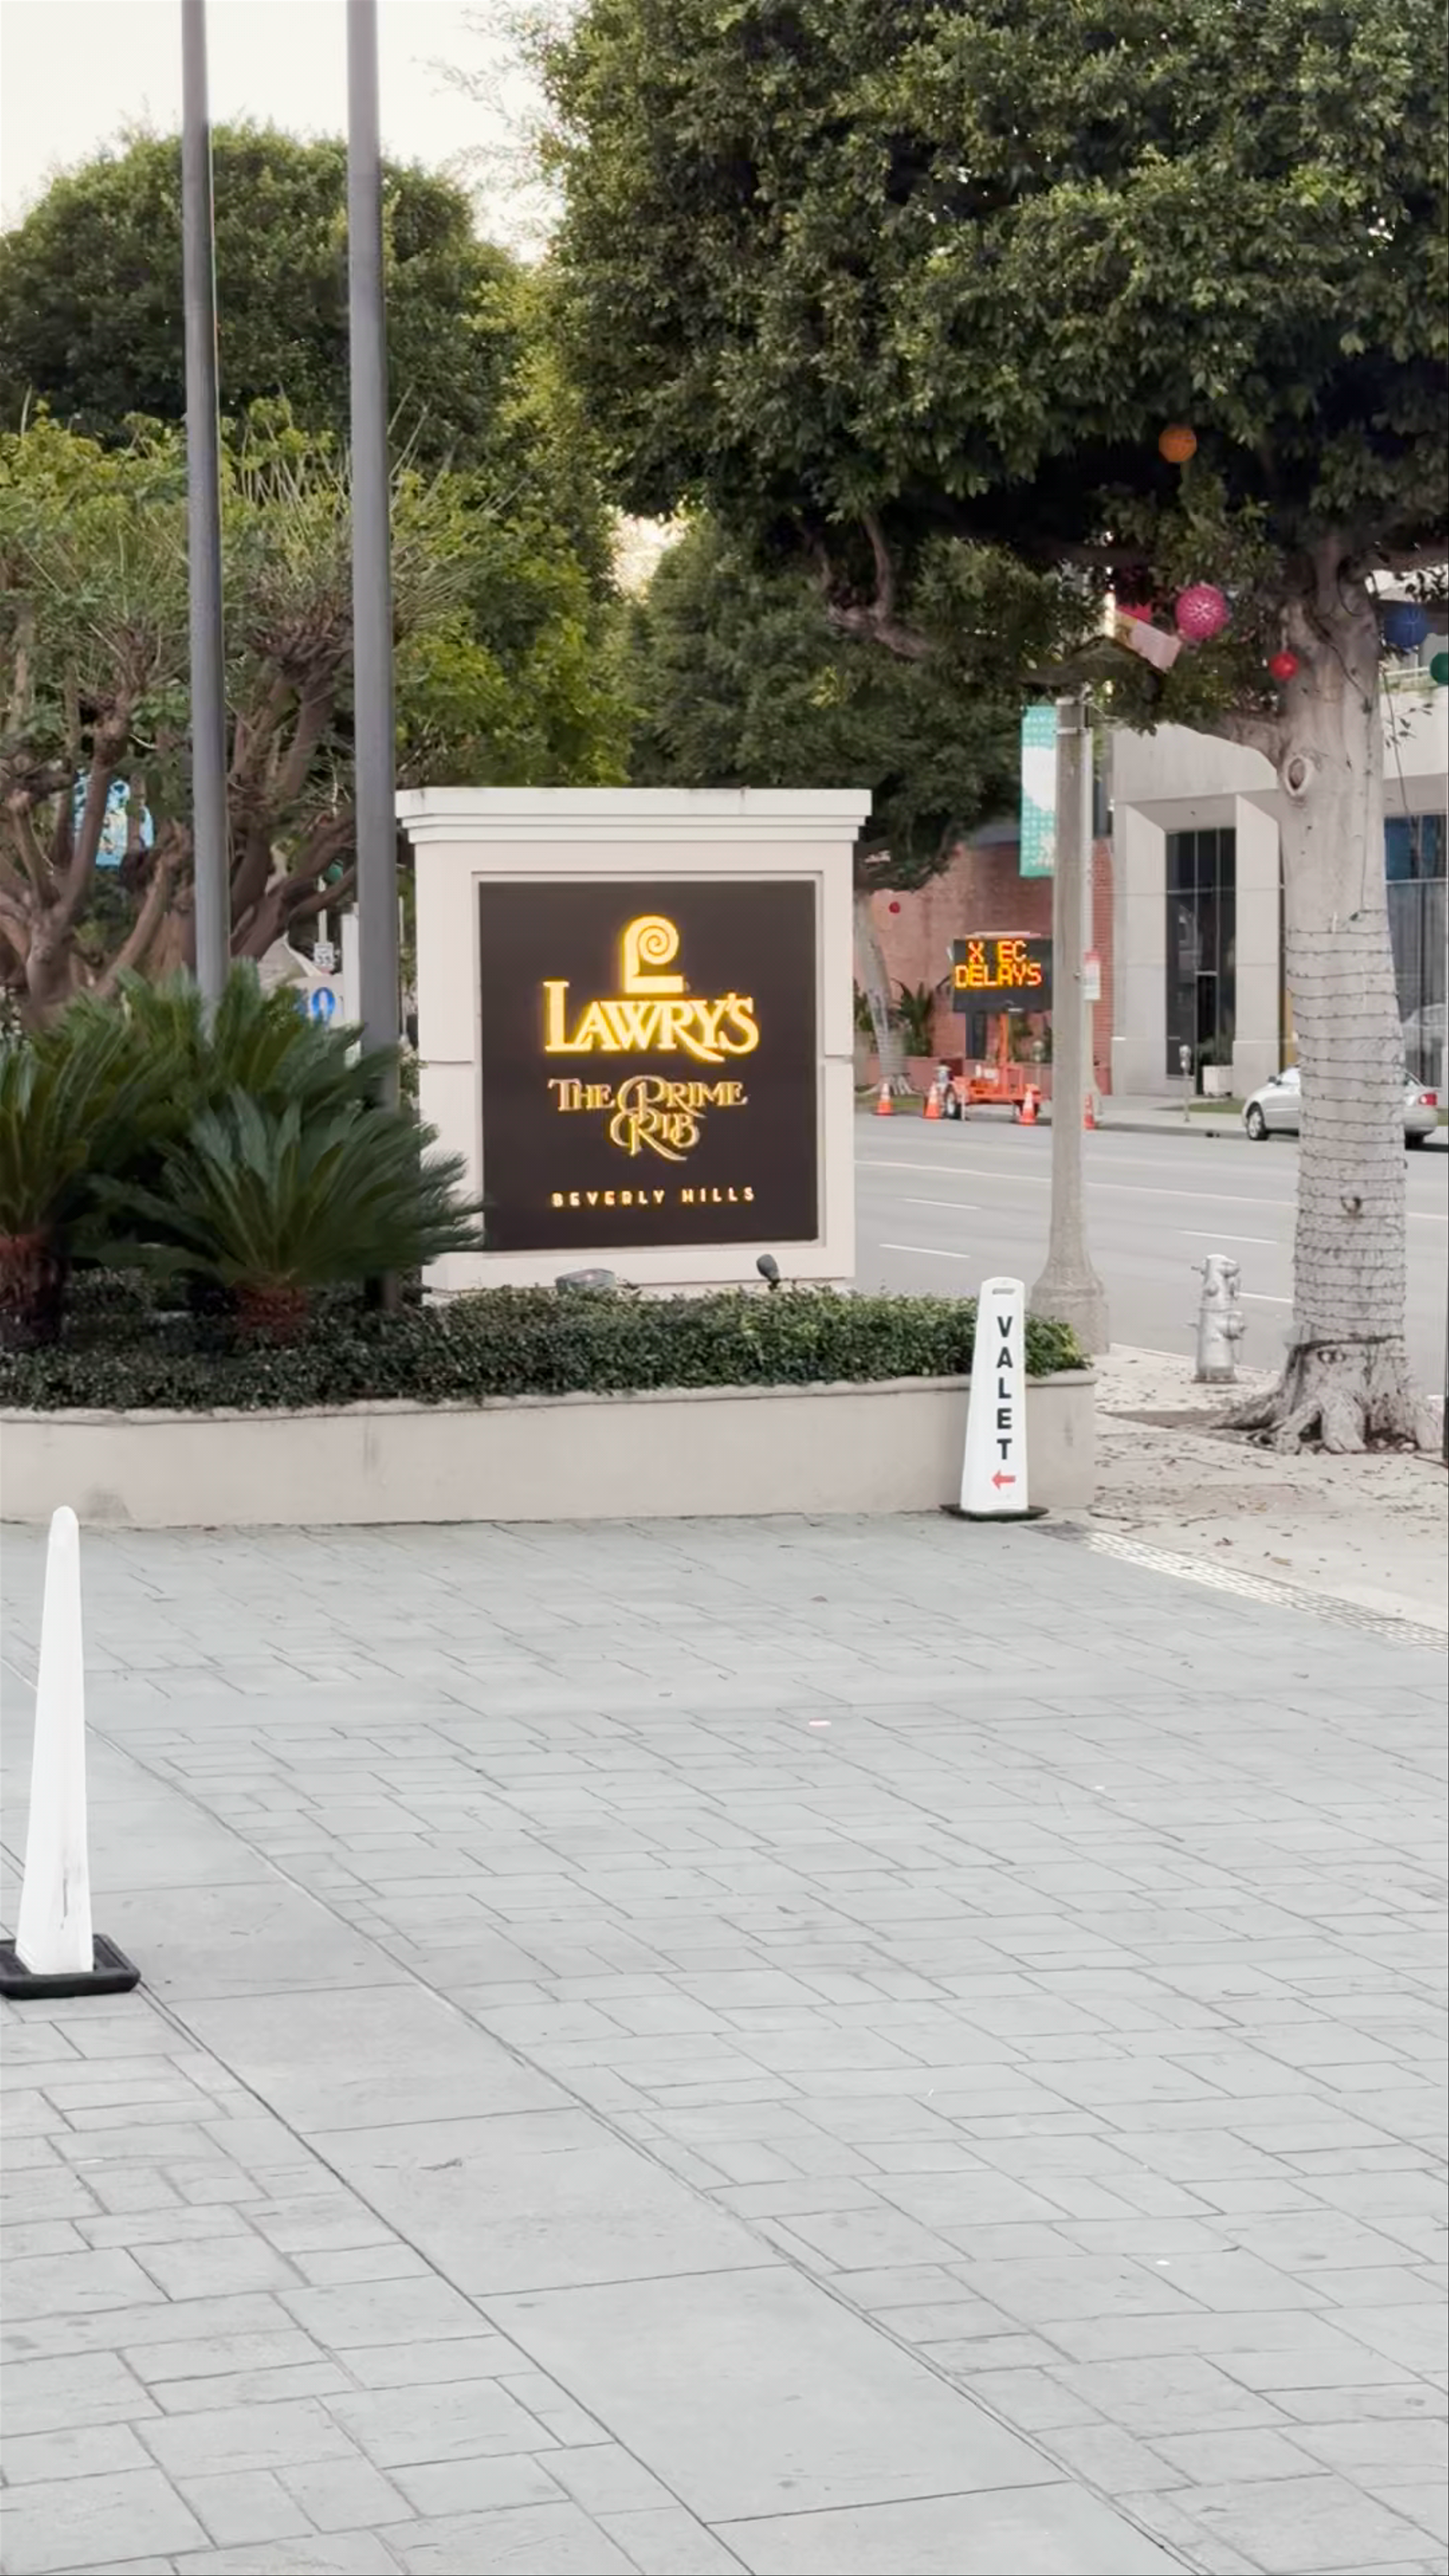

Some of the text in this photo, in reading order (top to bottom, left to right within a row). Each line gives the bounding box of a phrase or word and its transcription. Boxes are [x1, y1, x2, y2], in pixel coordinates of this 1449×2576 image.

[955, 963, 1042, 987] DELAYS
[968, 940, 1027, 963] X EC
[543, 981, 759, 1062] LAWRY'S
[548, 1075, 749, 1124] THE PRIME
[609, 1106, 700, 1161] RIB
[552, 1186, 754, 1207] BEVERLY HILLS
[996, 1315, 1013, 1460] VALET
